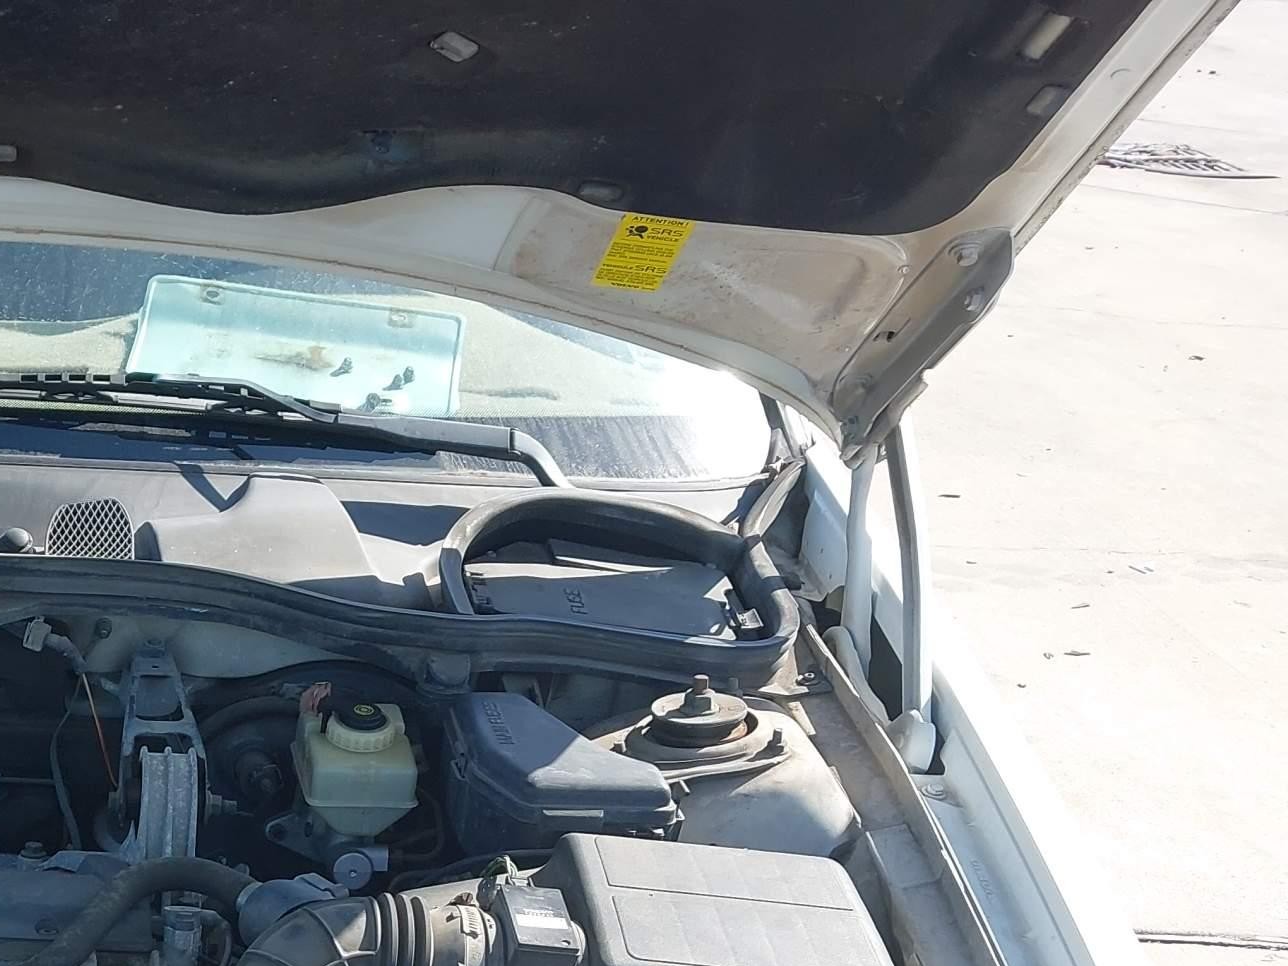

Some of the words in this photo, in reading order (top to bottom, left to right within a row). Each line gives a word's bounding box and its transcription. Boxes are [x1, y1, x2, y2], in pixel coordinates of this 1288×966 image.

[650, 227, 684, 237] SRS
[634, 264, 667, 274] SRS
[563, 584, 589, 616] FUSE
